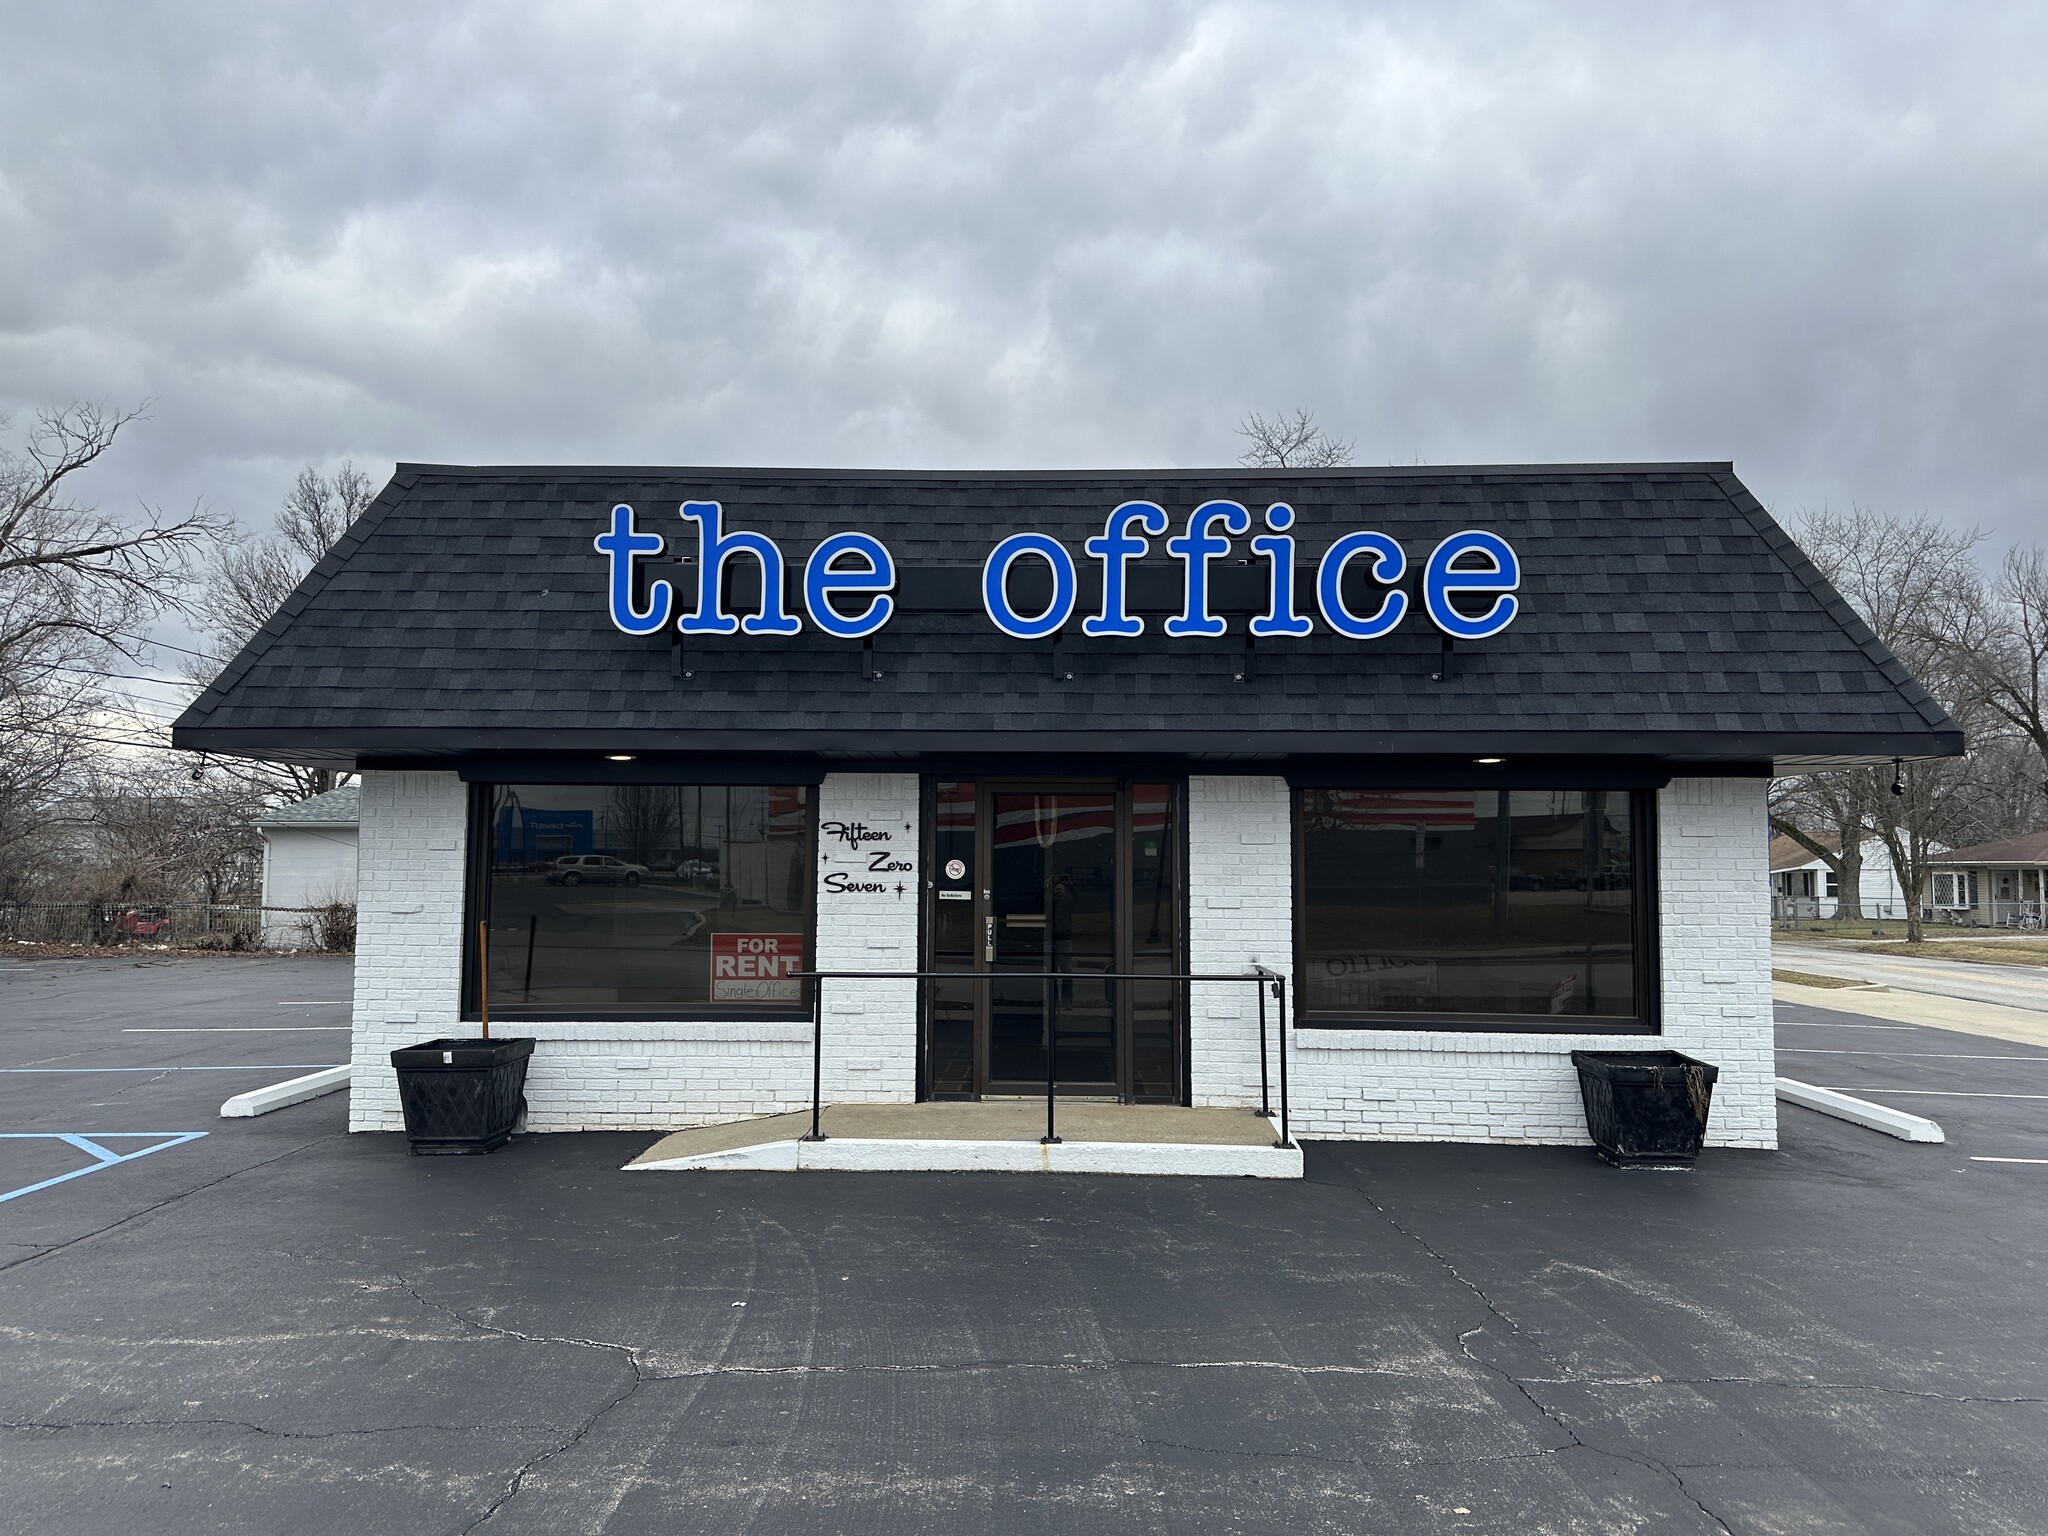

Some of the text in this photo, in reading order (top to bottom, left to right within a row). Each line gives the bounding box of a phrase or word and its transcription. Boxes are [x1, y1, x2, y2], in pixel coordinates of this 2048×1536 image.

[595, 501, 1521, 639] the office
[821, 822, 892, 850] Fifteen
[868, 852, 913, 872] Zero
[824, 873, 886, 893] Seven
[737, 938, 779, 954] FOR
[716, 955, 800, 977] RENT
[715, 981, 754, 999] Single
